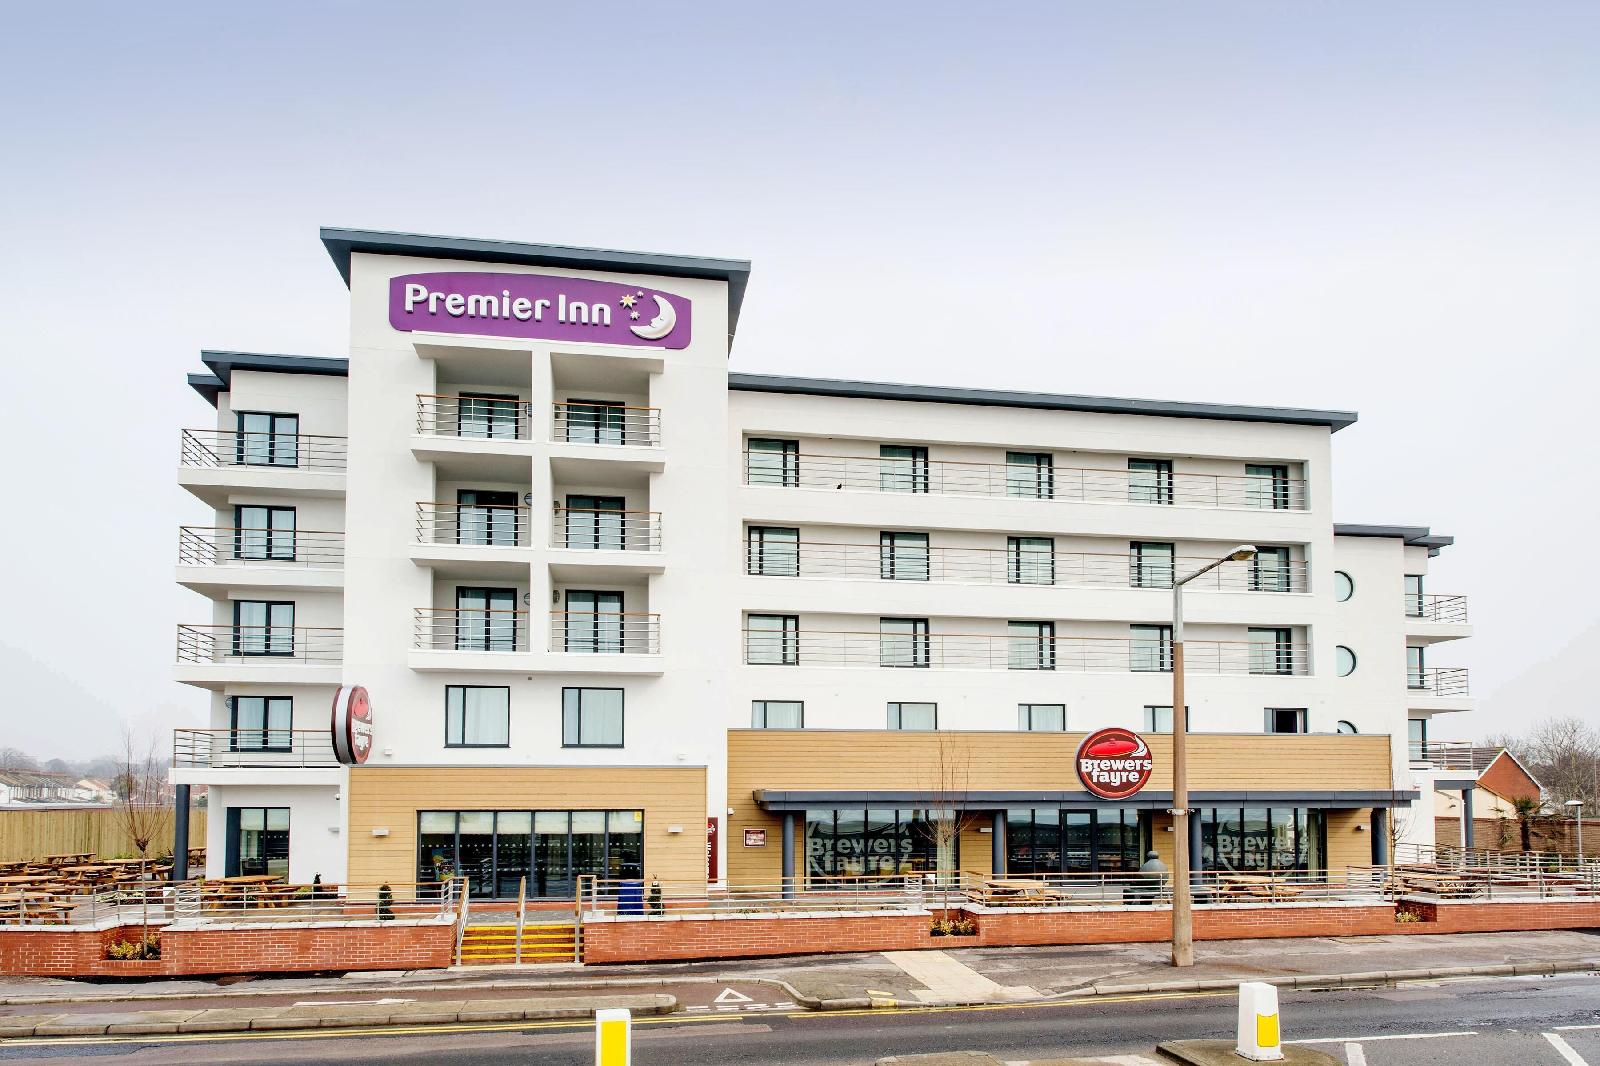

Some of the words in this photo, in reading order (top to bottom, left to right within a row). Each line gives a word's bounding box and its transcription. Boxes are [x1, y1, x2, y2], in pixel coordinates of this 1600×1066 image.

[405, 283, 551, 322] Premier
[558, 294, 612, 327] Inn
[1080, 758, 1153, 772] Brewers
[1091, 768, 1140, 787] fayre
[811, 838, 914, 856] Brewers
[823, 850, 896, 875] fayre
